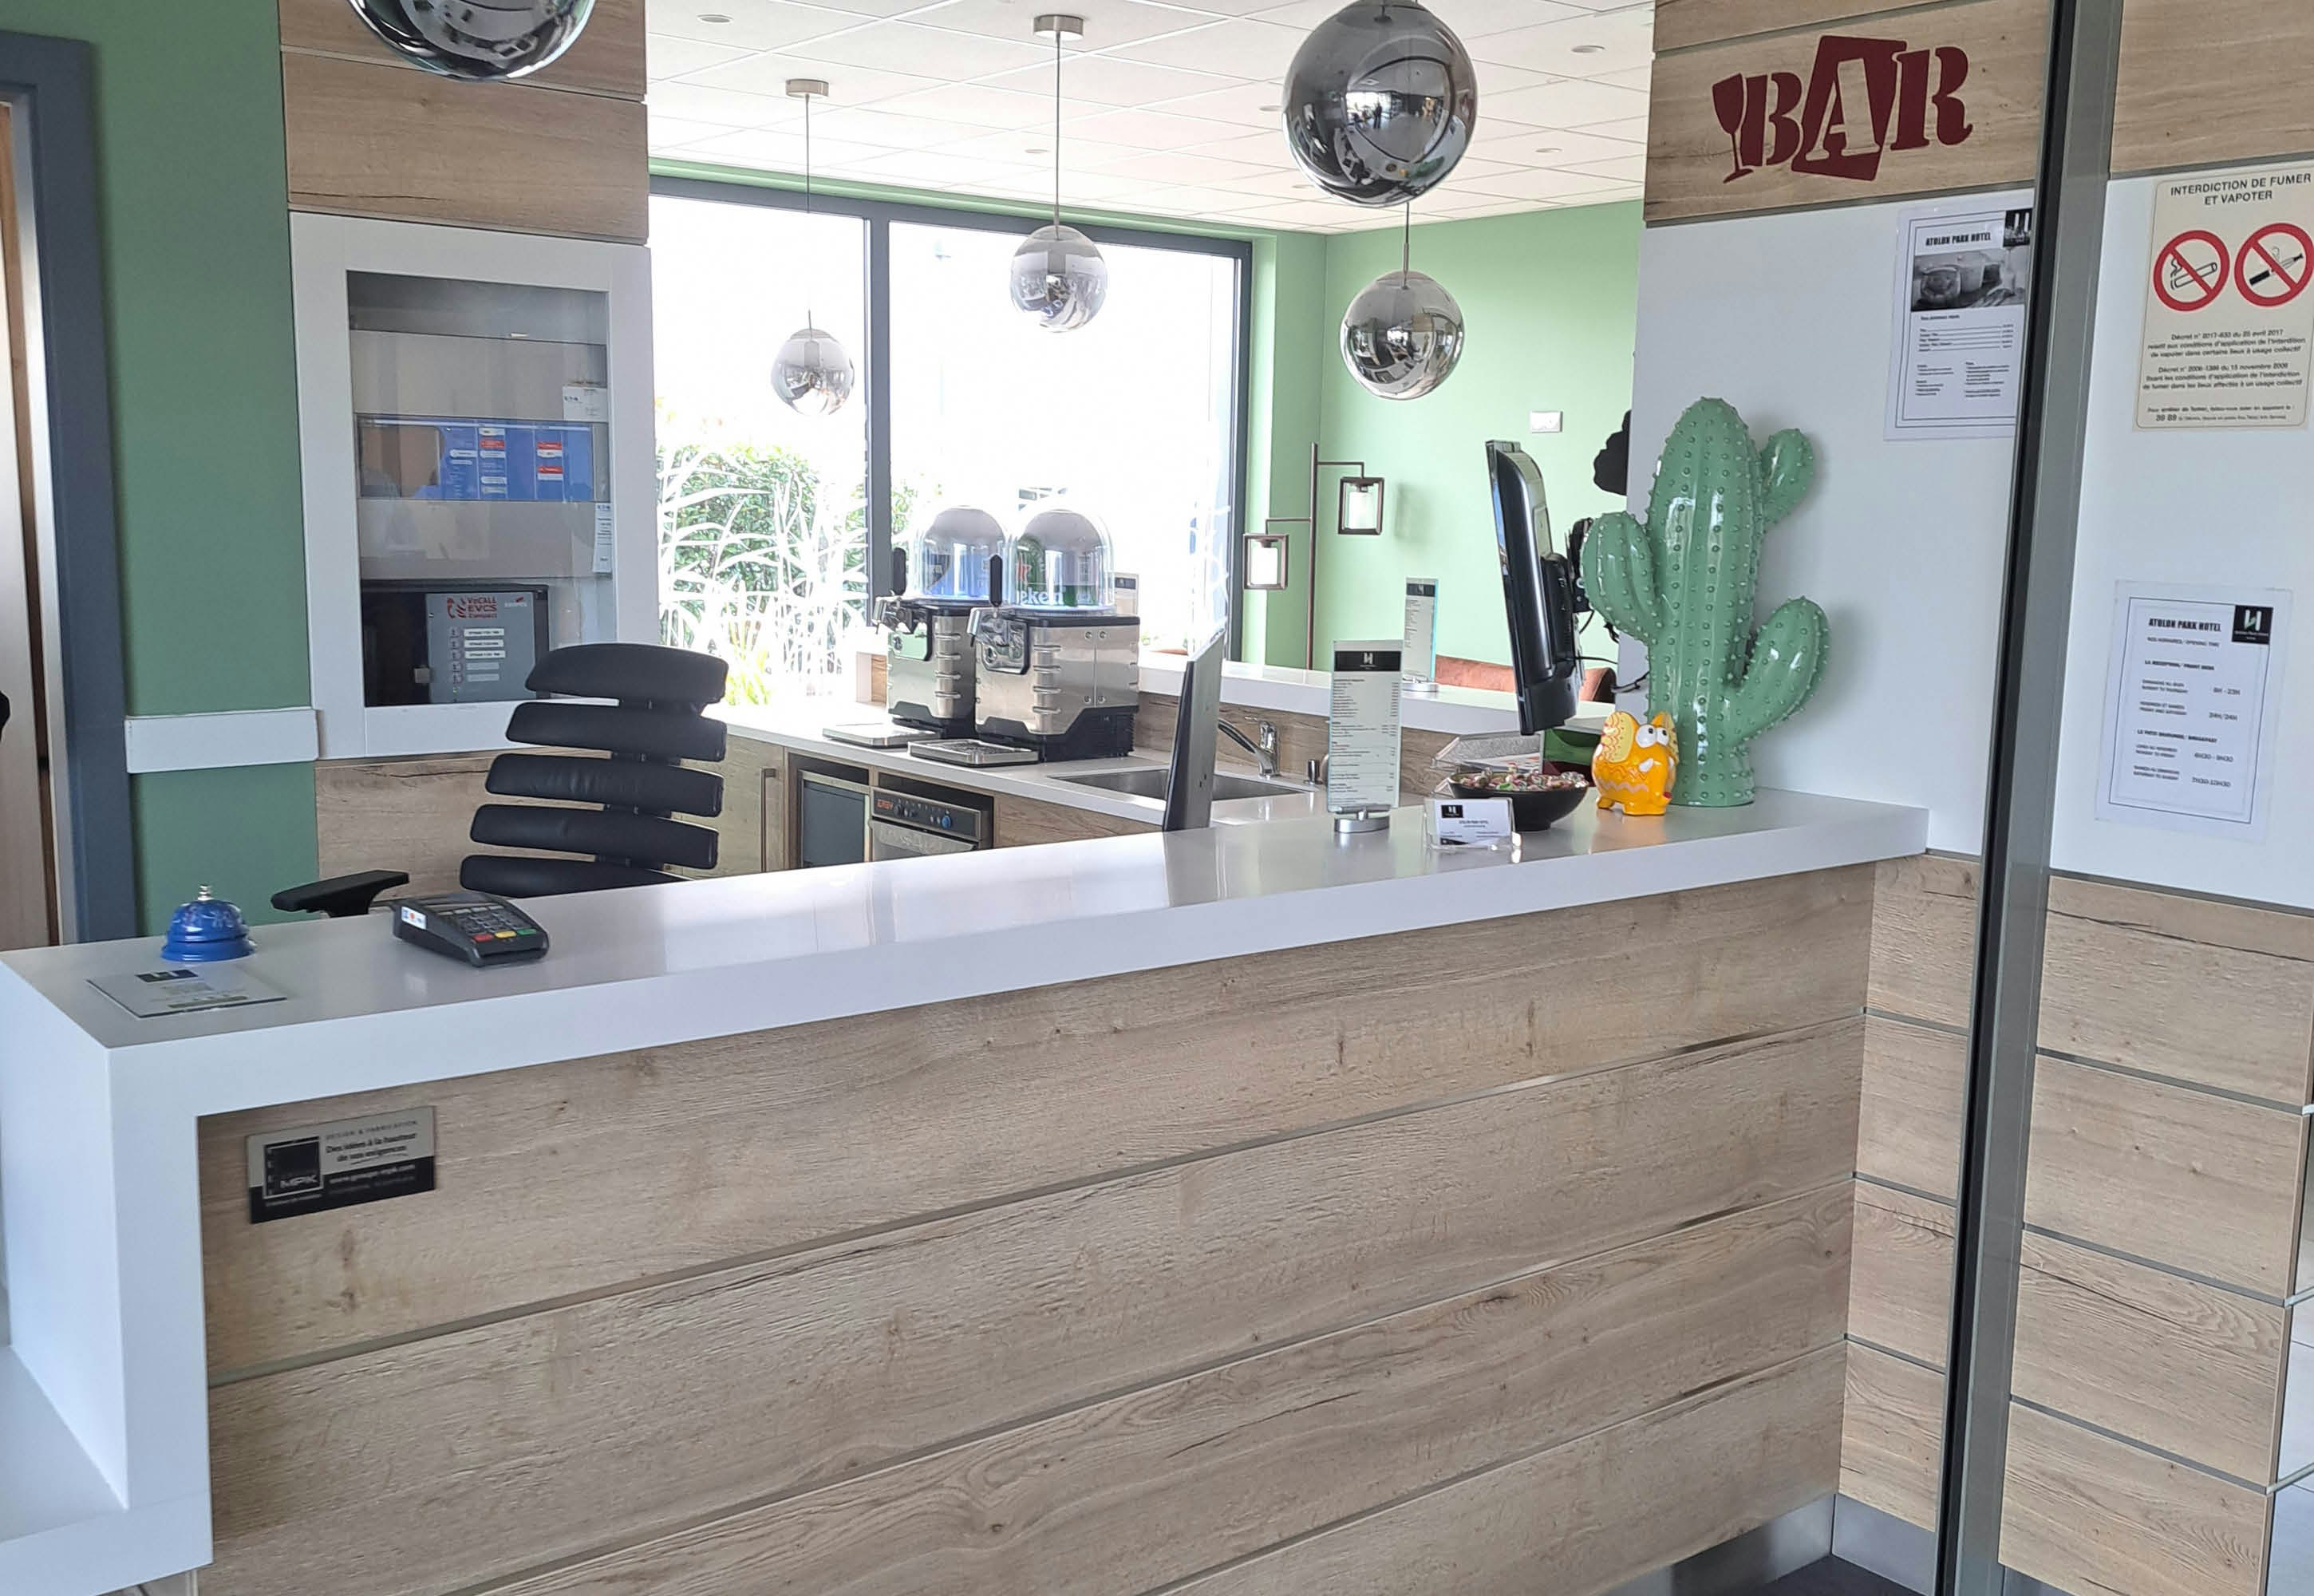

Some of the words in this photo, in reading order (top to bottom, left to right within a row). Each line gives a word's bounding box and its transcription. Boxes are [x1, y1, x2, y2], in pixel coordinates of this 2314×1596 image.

[1740, 37, 1973, 180] BAR
[2170, 179, 2247, 196] INTERDICTION
[2251, 178, 2266, 188] DE
[2270, 173, 2311, 186] FUMER
[2205, 196, 2217, 205] ET
[2221, 190, 2273, 204] VAPOTER
[1952, 234, 1969, 244] PARK
[1971, 232, 1991, 243] HOTEL
[2149, 617, 2177, 629] ATOLON
[2178, 620, 2198, 630] PARK
[2198, 622, 2221, 632] HOTEL
